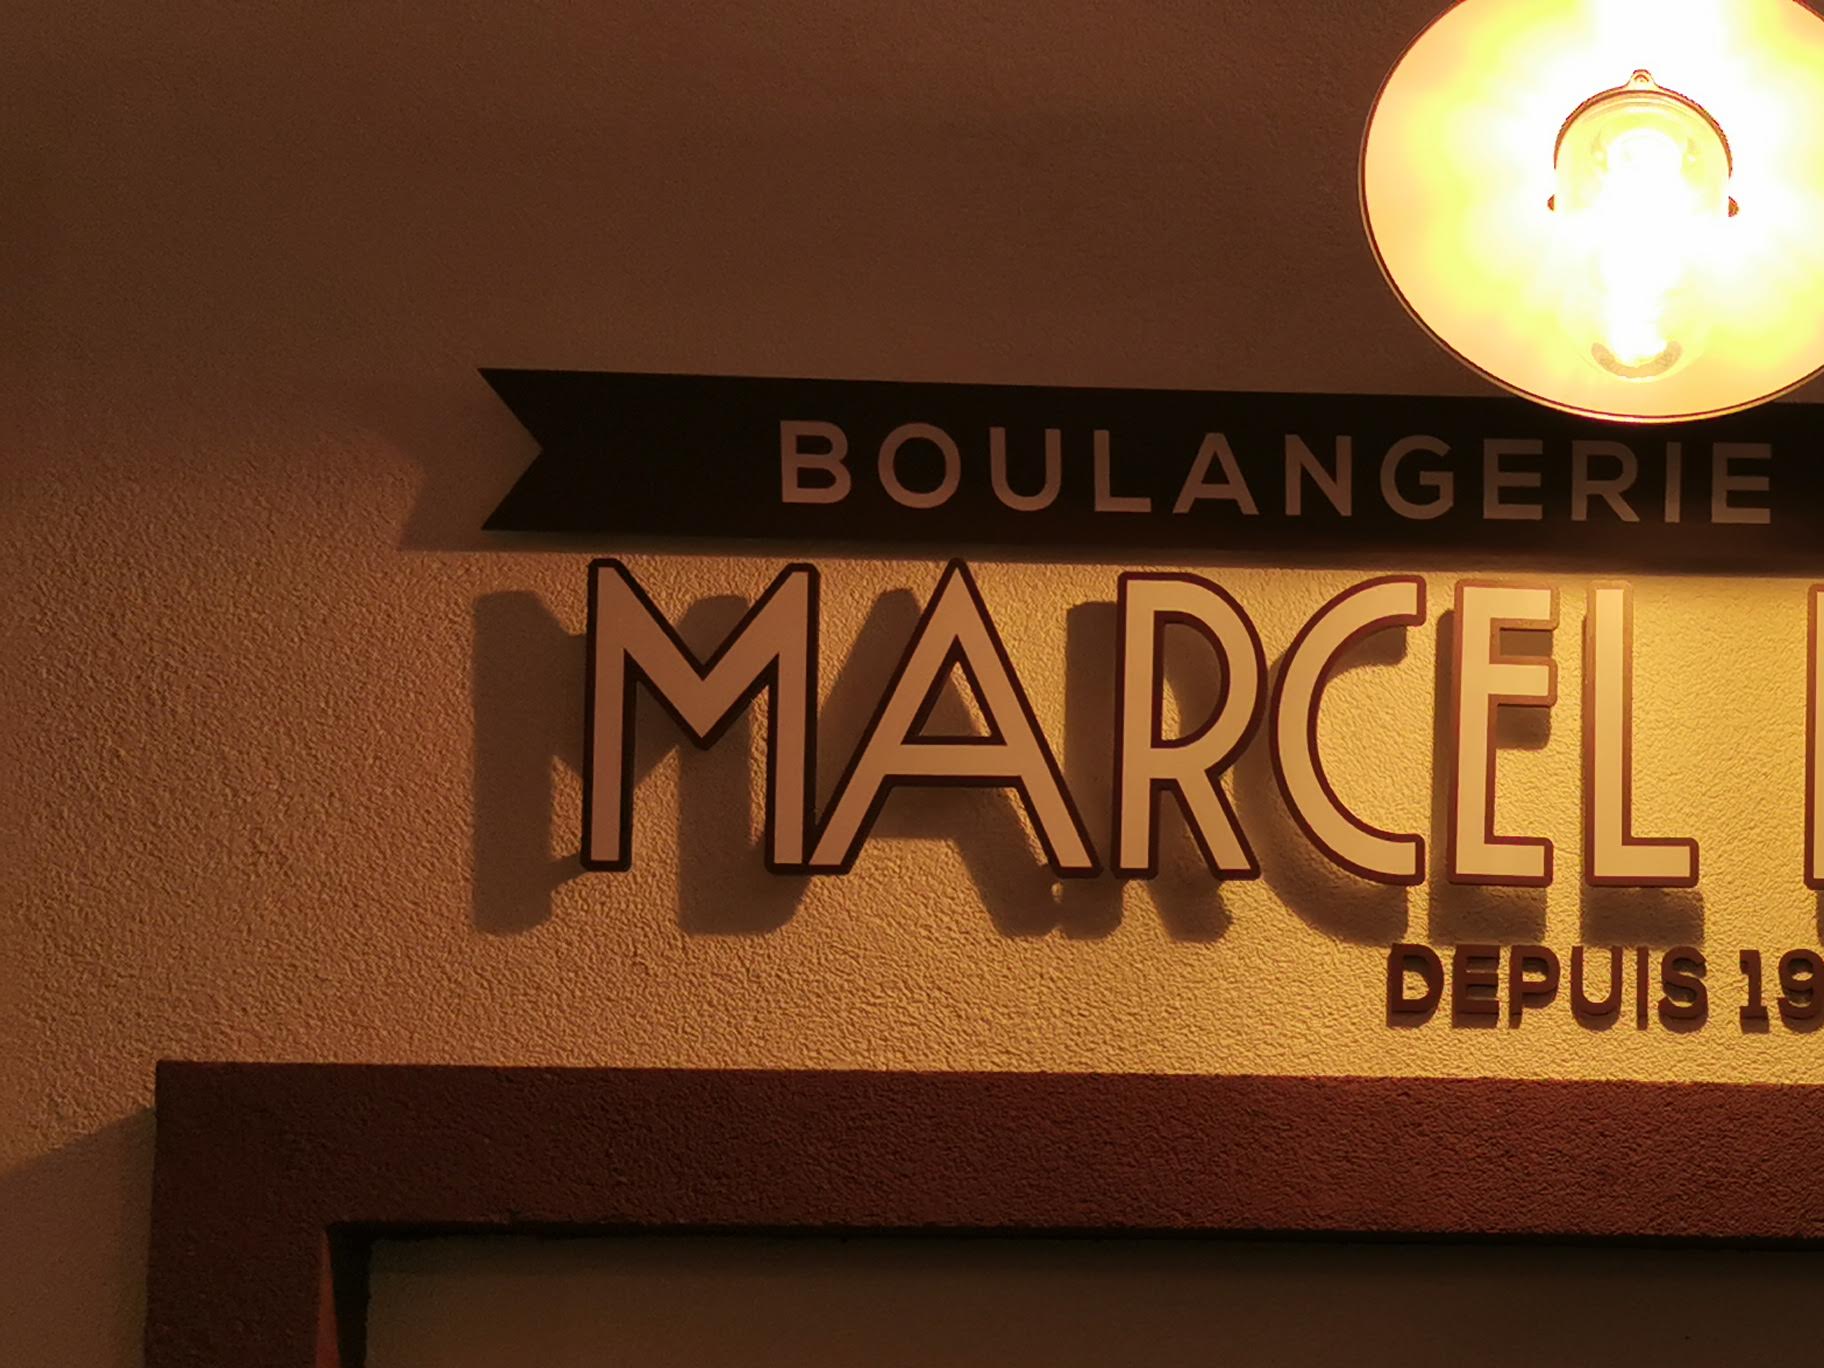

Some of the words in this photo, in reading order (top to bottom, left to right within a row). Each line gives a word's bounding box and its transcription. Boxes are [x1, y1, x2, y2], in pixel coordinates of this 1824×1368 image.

[779, 418, 1774, 526] BOULANGERIE
[581, 556, 1700, 888] MARCEL
[1387, 943, 1709, 1030] DEPUIS
